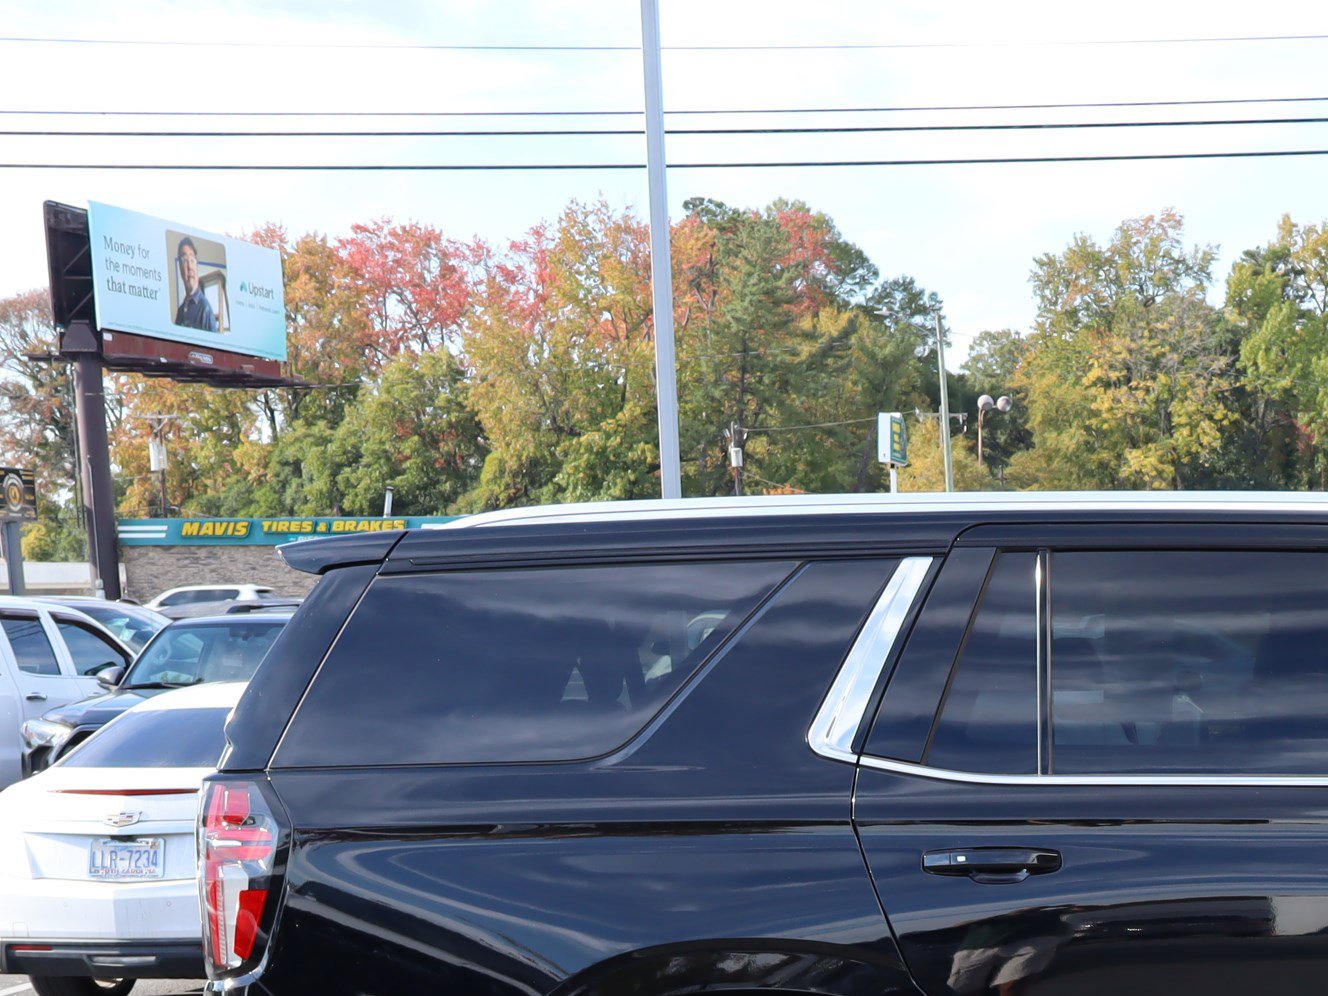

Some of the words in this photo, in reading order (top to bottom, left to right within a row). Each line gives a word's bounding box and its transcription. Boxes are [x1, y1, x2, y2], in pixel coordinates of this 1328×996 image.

[103, 235, 135, 259] Money
[138, 244, 150, 260] for
[105, 257, 120, 272] the
[122, 263, 162, 282] moments
[107, 275, 126, 294] that
[128, 284, 158, 300] matter
[248, 281, 274, 299] Upstart
[181, 521, 249, 536] MAVIS
[262, 520, 314, 532] TIRES
[316, 522, 328, 532] &
[332, 519, 406, 532] BRAKES
[92, 849, 158, 868] LLR-7234
